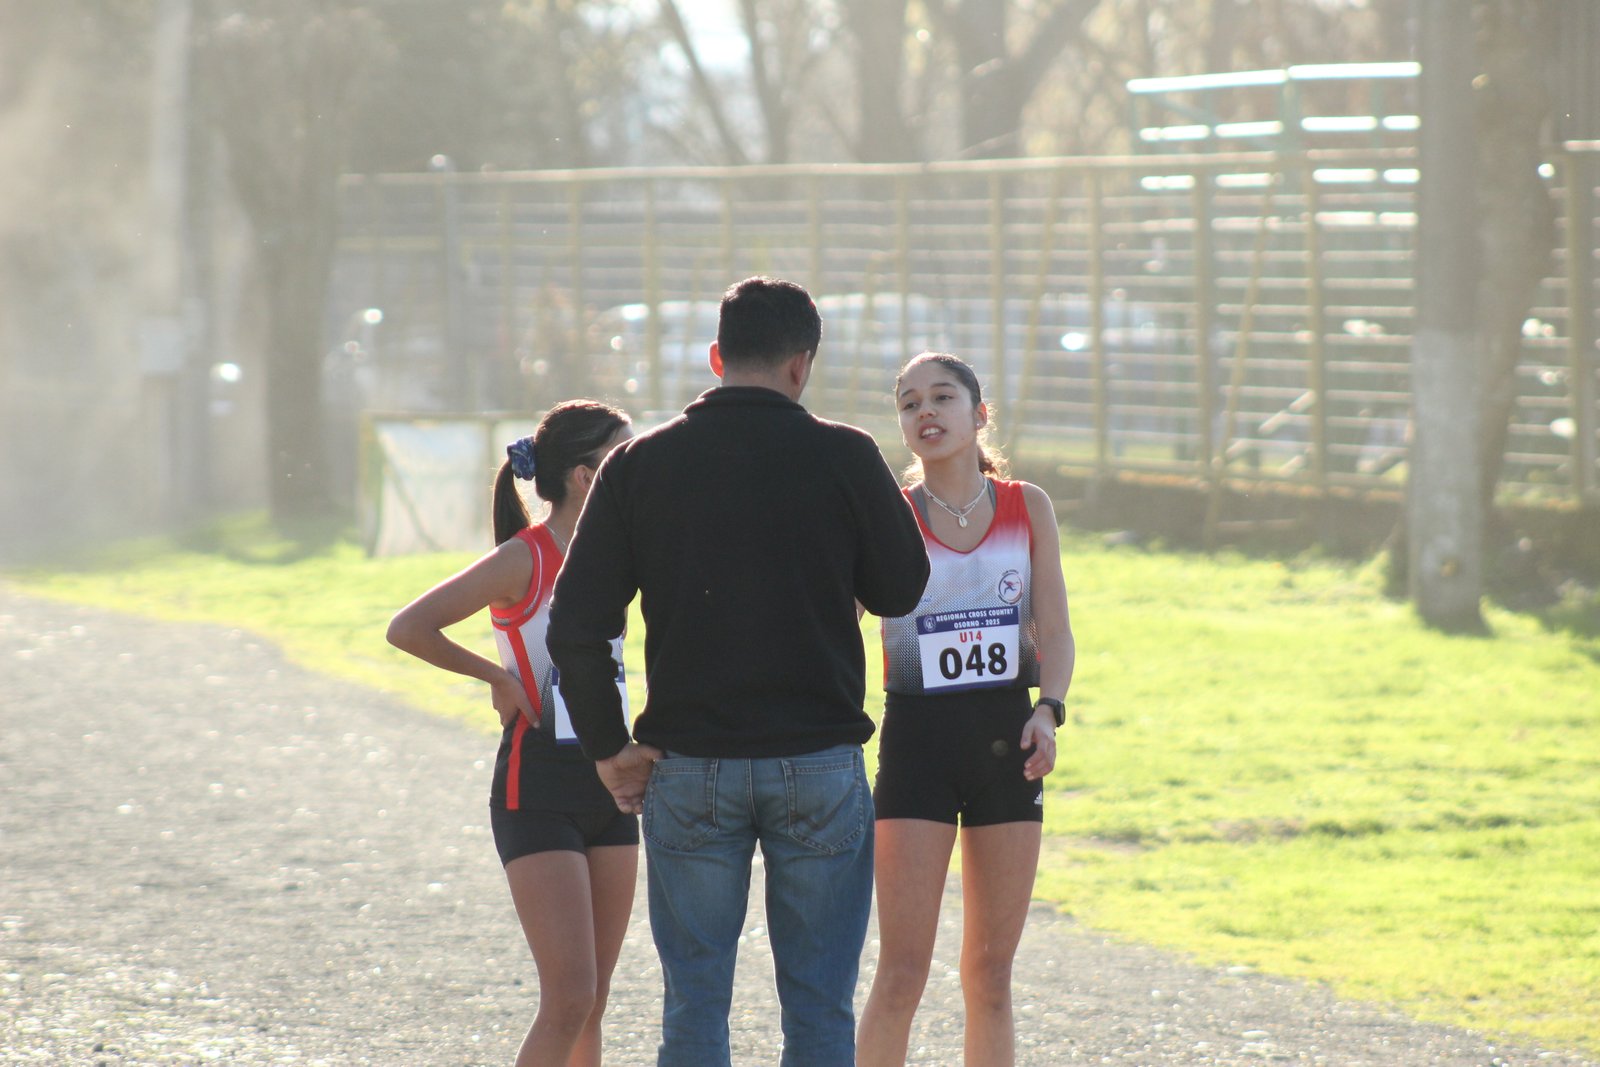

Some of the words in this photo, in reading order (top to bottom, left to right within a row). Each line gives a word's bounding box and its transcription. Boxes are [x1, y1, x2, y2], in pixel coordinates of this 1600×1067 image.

[936, 612, 967, 622] REGIONAL
[988, 608, 1013, 616] COUNTRY
[954, 620, 979, 629] OSORNO
[985, 618, 1000, 626] 2025
[960, 631, 982, 643] U14
[939, 642, 1007, 680] 048
